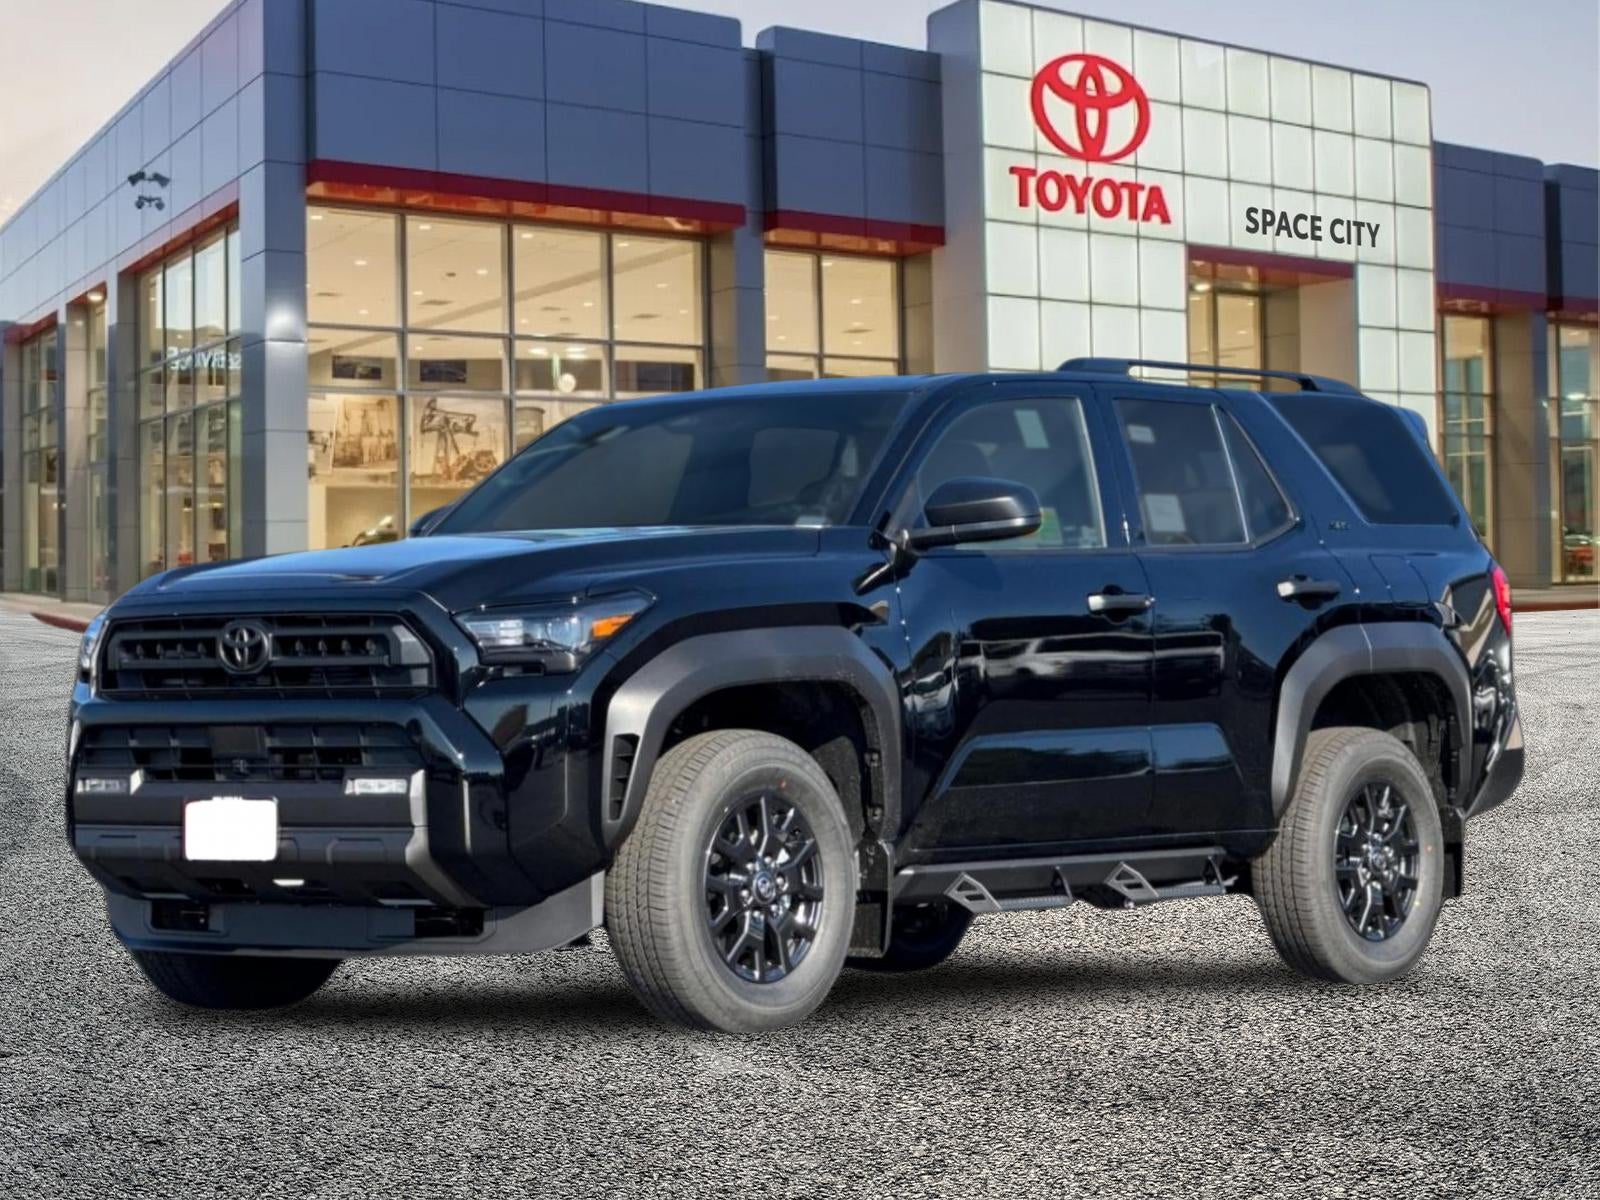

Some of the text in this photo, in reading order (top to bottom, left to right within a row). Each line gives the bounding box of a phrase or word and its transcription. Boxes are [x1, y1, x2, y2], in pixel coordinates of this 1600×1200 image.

[1009, 166, 1172, 224] TOYOTA
[1245, 206, 1381, 248] SPACE CITY
